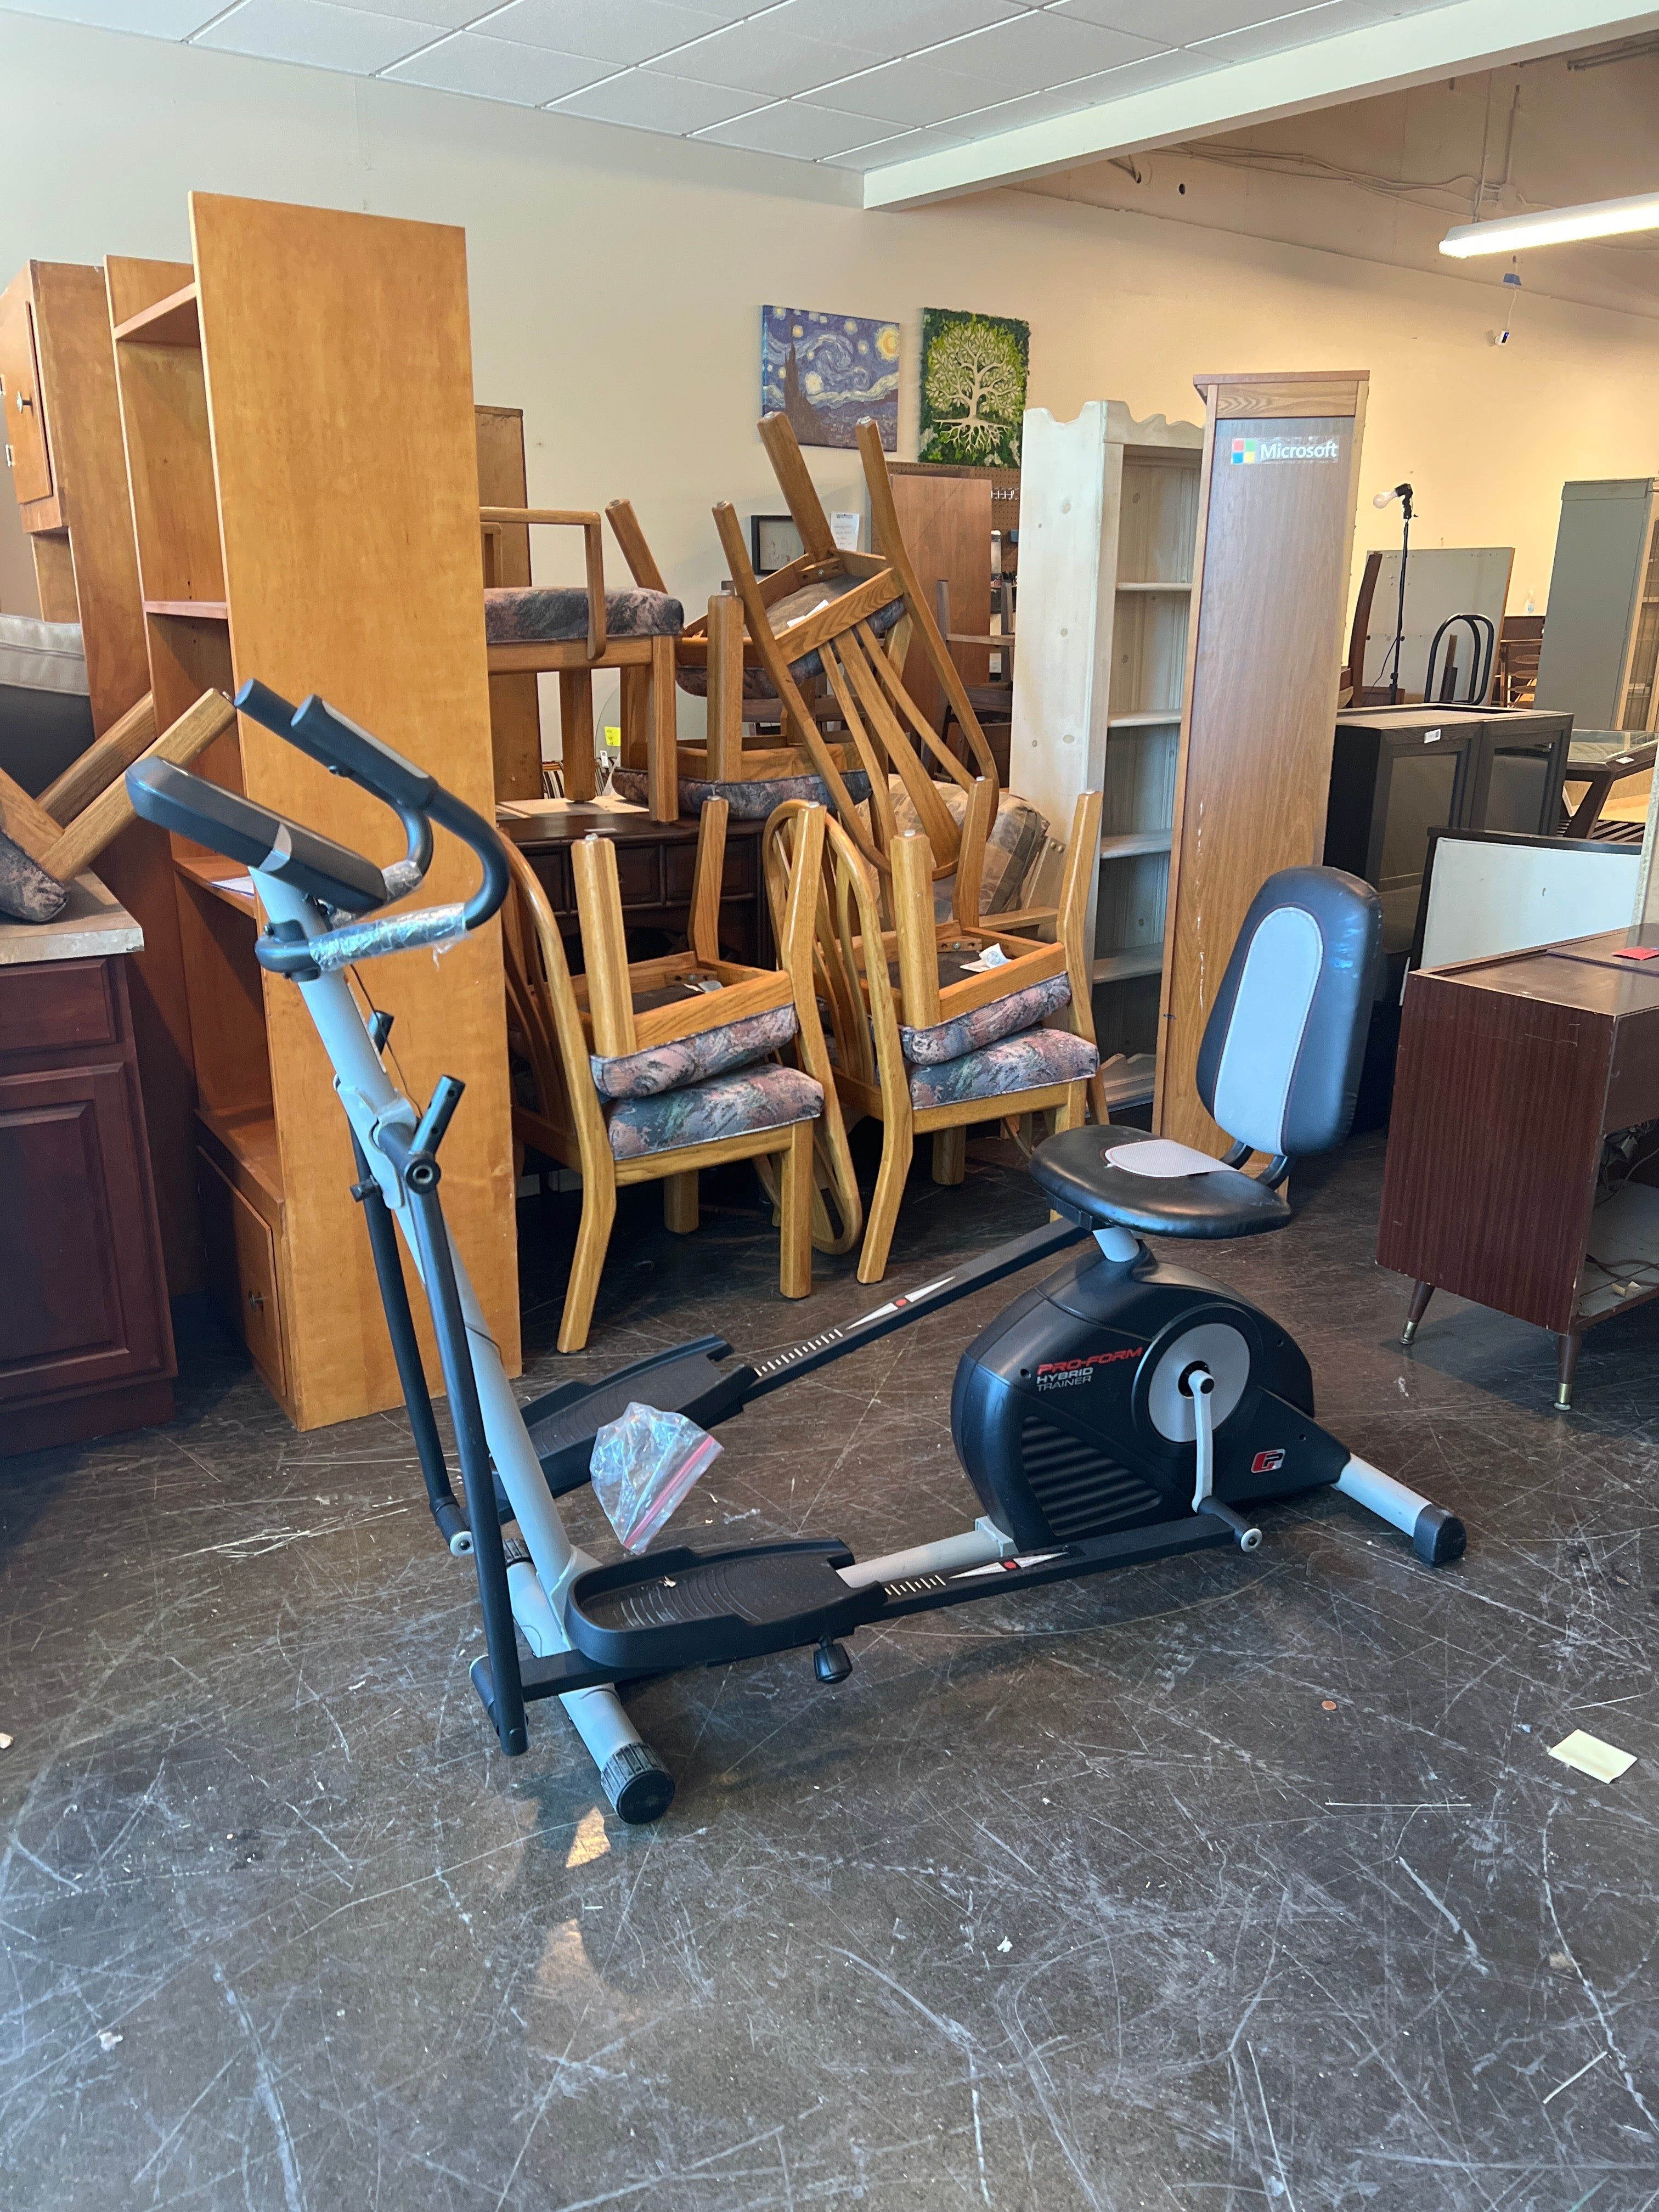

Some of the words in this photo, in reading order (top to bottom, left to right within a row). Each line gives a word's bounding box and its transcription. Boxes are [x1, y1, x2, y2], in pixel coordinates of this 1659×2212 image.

[1261, 441, 1338, 459] Microsoft
[1037, 1347, 1143, 1375] PRO-FORM
[1037, 1367, 1093, 1384] HYBRID
[1037, 1376, 1091, 1392] TRAINER
